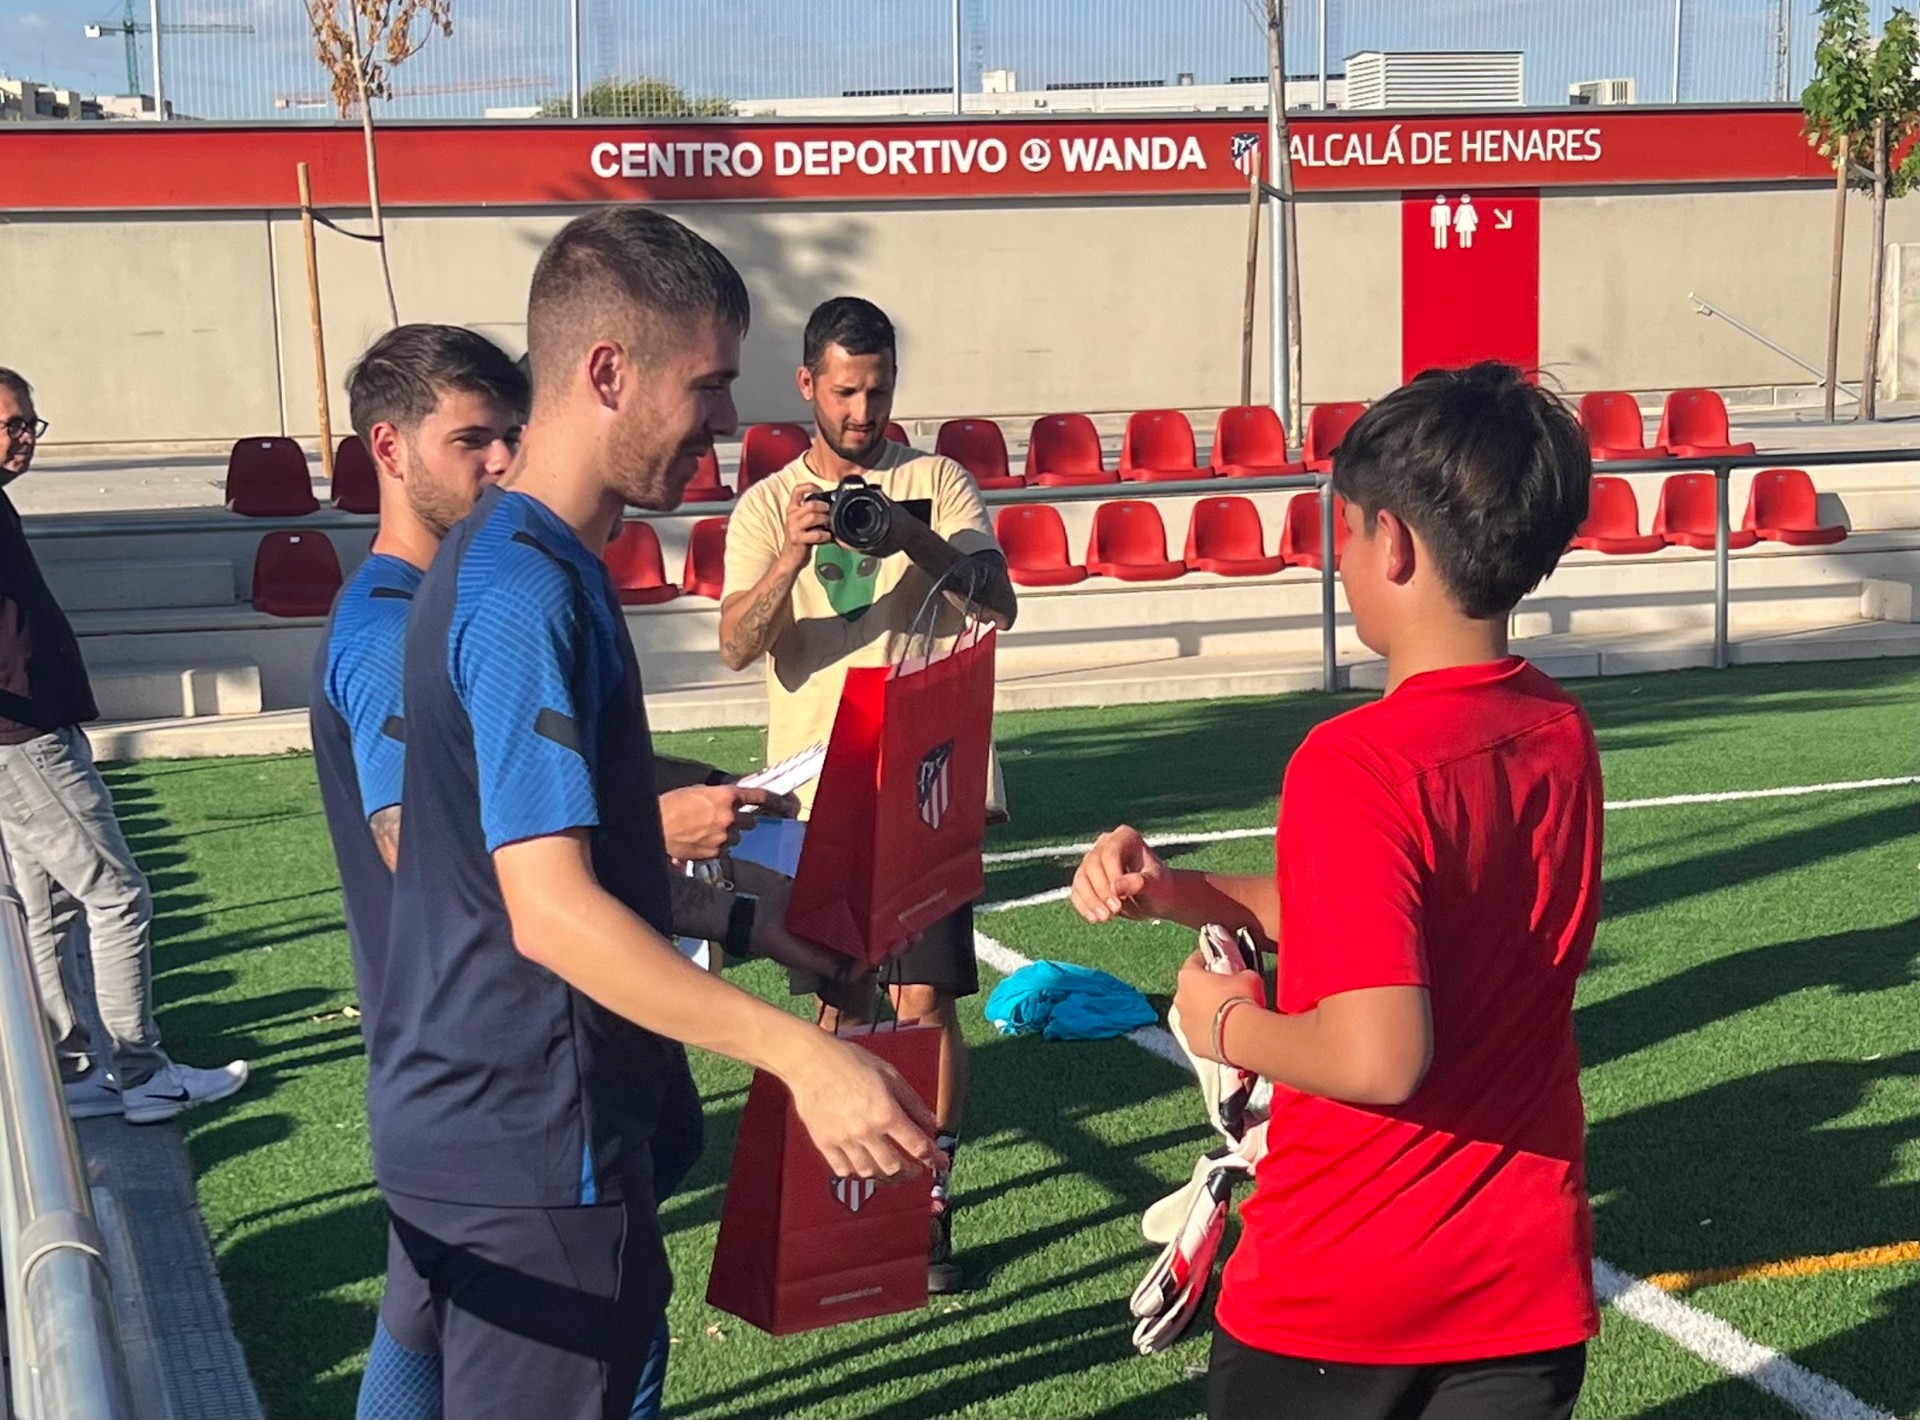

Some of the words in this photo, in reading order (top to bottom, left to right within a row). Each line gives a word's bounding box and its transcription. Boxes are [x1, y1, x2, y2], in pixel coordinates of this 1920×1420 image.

[590, 141, 763, 179] CENTRO
[774, 137, 1008, 177] DEPORTIVO
[1059, 135, 1208, 173] WANDA
[1289, 124, 1405, 167] ALCALÁ
[1411, 130, 1453, 166] DE
[1461, 127, 1602, 164] HENARES
